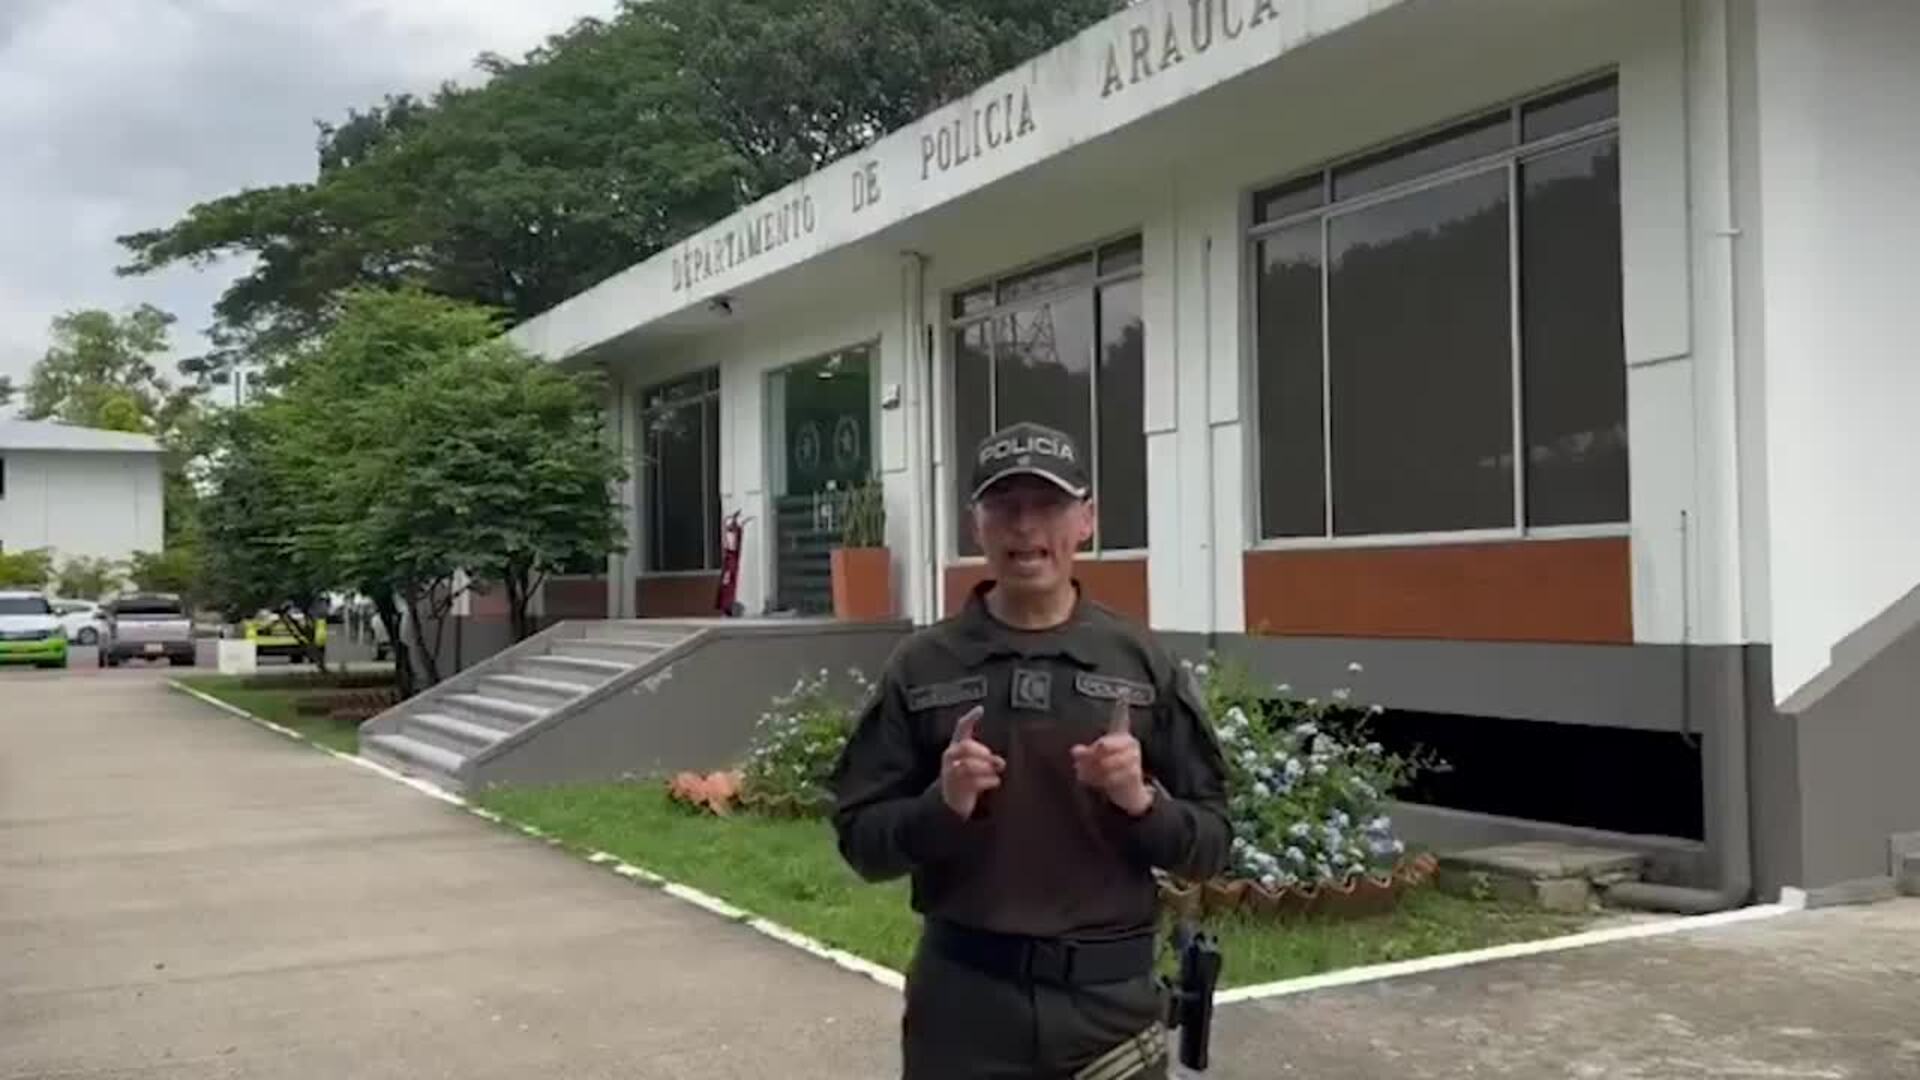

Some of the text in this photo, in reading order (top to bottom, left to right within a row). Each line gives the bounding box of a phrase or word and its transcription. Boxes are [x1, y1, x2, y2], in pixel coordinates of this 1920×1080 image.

[672, 0, 1279, 291] DEPARTAMENTO DE POLICIA ARAUCA
